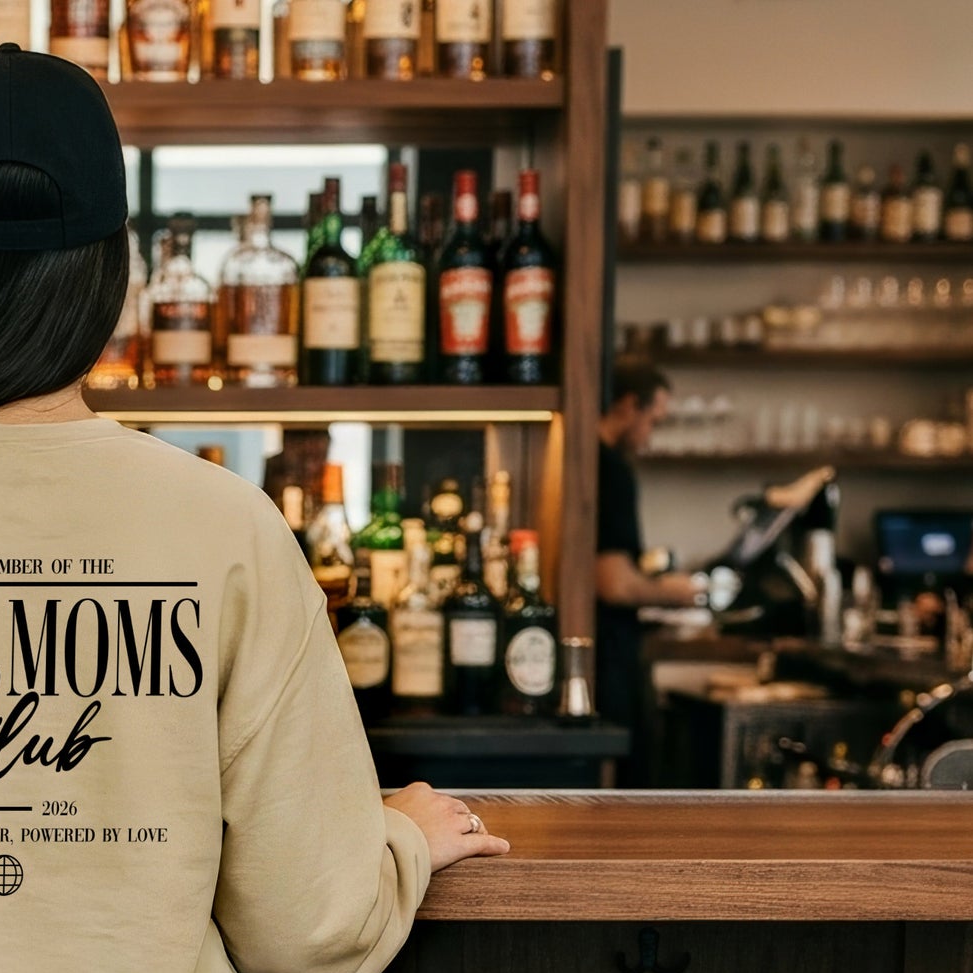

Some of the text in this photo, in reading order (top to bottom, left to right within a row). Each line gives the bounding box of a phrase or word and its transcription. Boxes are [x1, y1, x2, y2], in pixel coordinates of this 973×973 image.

[51, 558, 73, 575] OF
[80, 558, 114, 575] THE
[7, 597, 204, 698] MOMS
[42, 800, 78, 817] 2026
[21, 827, 96, 843] POWERED
[102, 827, 122, 843] BY
[128, 827, 168, 843] LOVE
